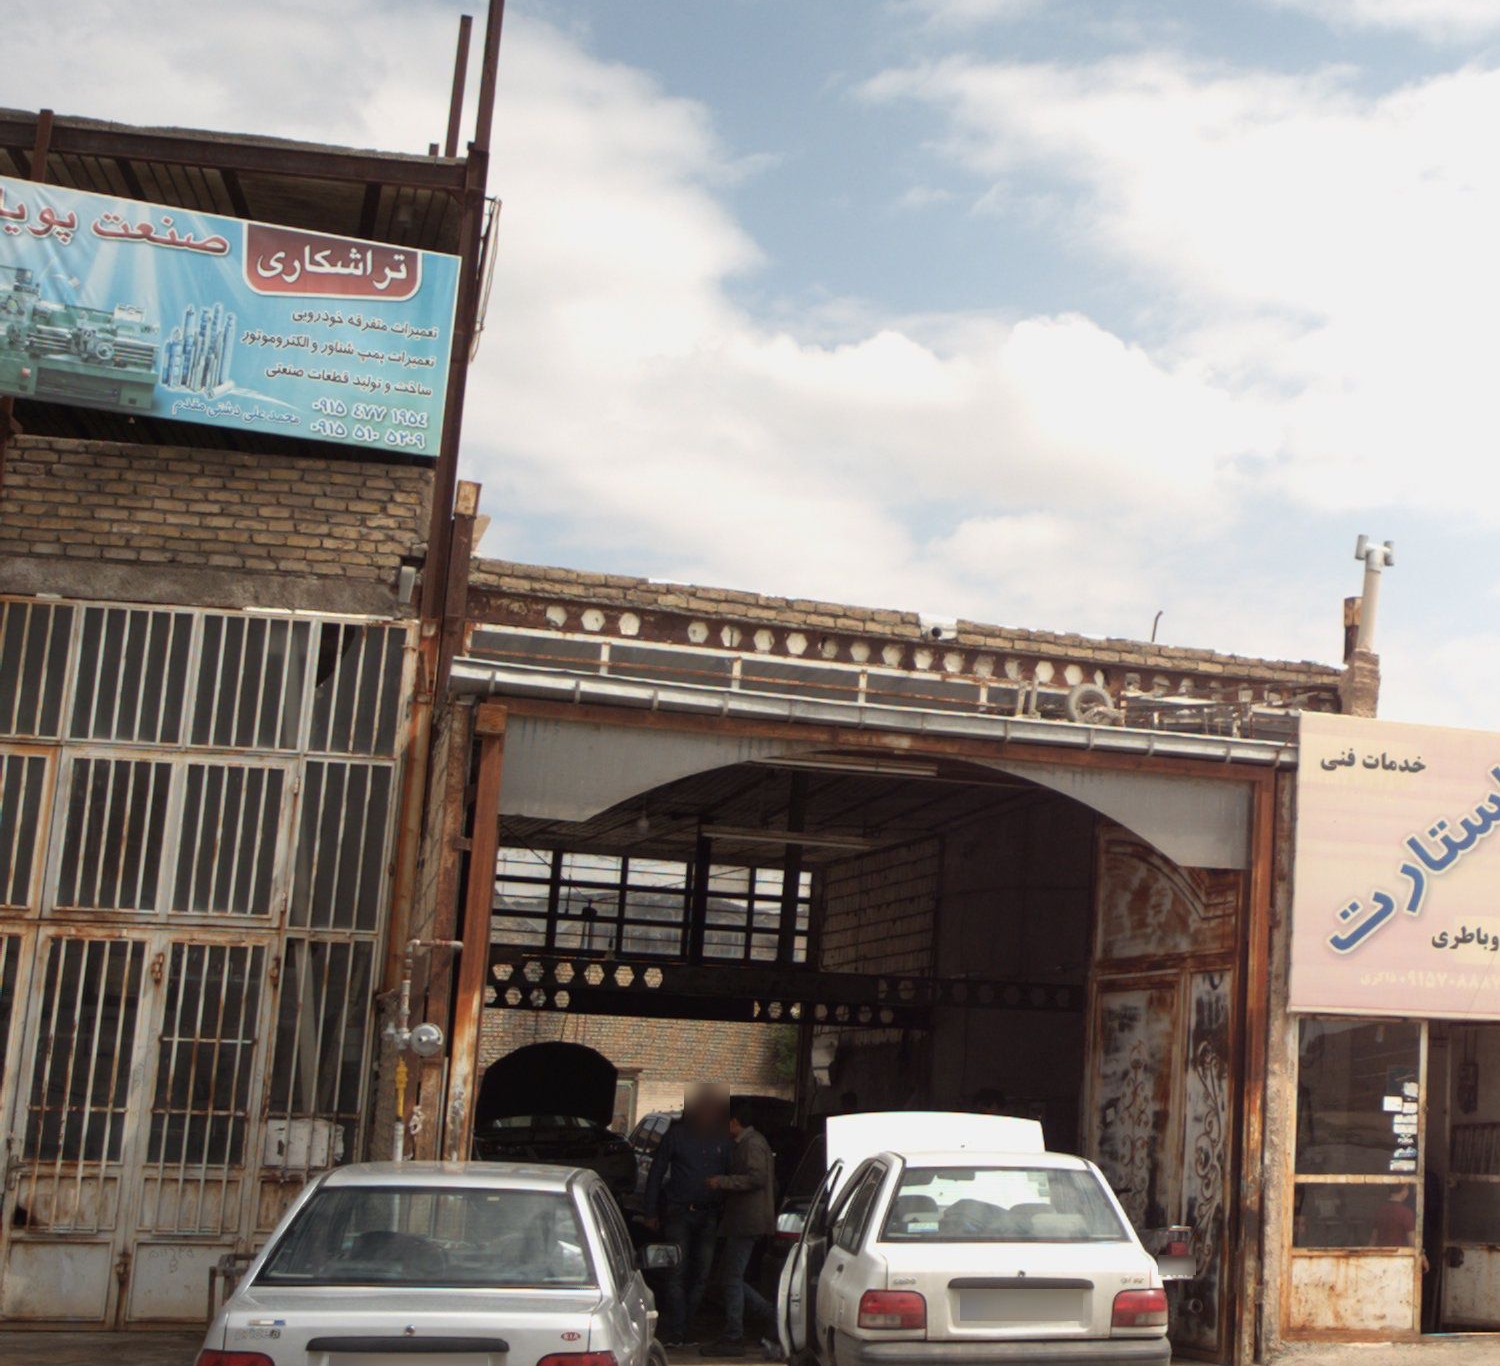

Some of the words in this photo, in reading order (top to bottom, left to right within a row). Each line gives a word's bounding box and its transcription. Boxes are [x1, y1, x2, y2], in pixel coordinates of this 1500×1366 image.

[93, 212, 229, 255] صنعت
[258, 245, 408, 290] تراشکاری
[347, 314, 388, 332] متفرقه
[391, 323, 438, 339] تعمیرات
[242, 329, 310, 349] الکتروموتور
[311, 341, 318, 353] و
[321, 341, 354, 356] شناور
[357, 349, 385, 363] پمپ
[388, 352, 435, 367] تعمیرات
[265, 363, 304, 378] صنعتی
[307, 369, 349, 385] قطعات
[352, 376, 382, 391] تولید
[384, 384, 391, 394] و
[394, 383, 432, 397] ساخت
[244, 406, 266, 421] علی
[268, 410, 300, 423] محمد
[1320, 747, 1356, 772] فنی
[1362, 752, 1427, 774] خدمات
